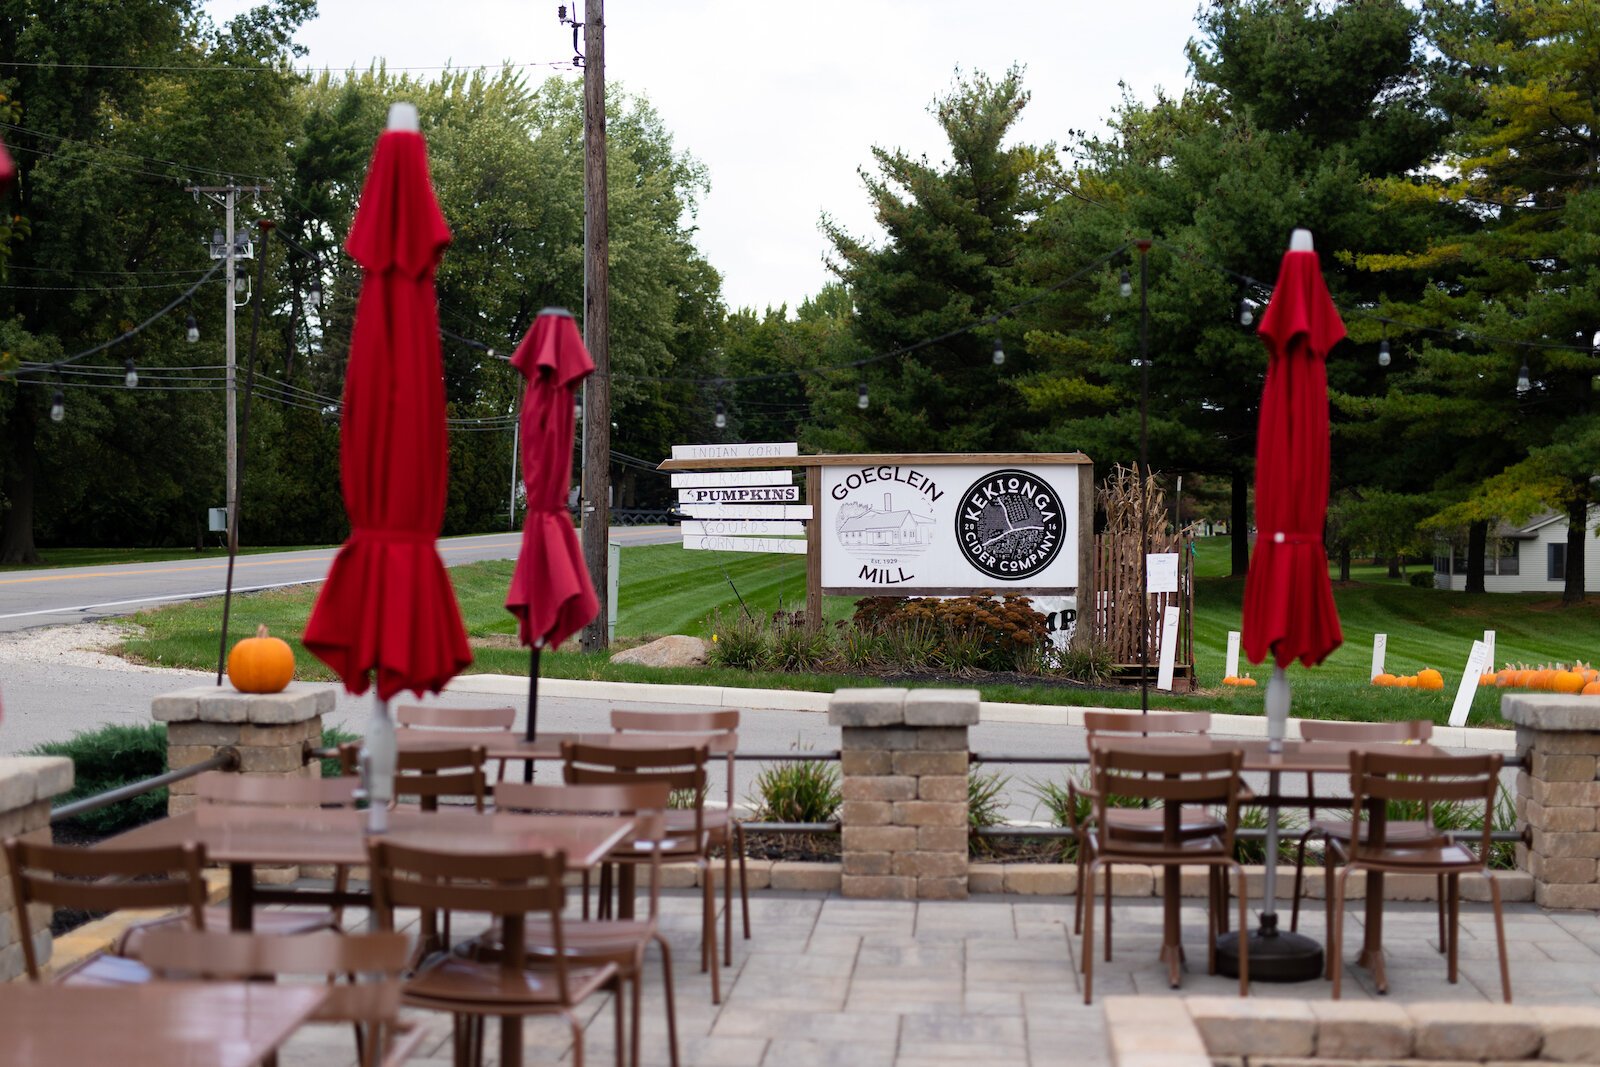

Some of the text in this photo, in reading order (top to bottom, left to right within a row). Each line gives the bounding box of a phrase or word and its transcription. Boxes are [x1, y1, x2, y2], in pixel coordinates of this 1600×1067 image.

[692, 445, 781, 458] INDIAN CORN
[831, 465, 944, 502] GOEGLEIN
[696, 488, 795, 502] PUMPKINS
[964, 478, 1057, 522] KEKIONGA
[705, 521, 769, 533] GOURDS
[701, 537, 796, 552] CORN STALKS
[965, 532, 1056, 572] CIDER COMPANY
[858, 565, 915, 584] MILL
[1167, 613, 1178, 627] 2
